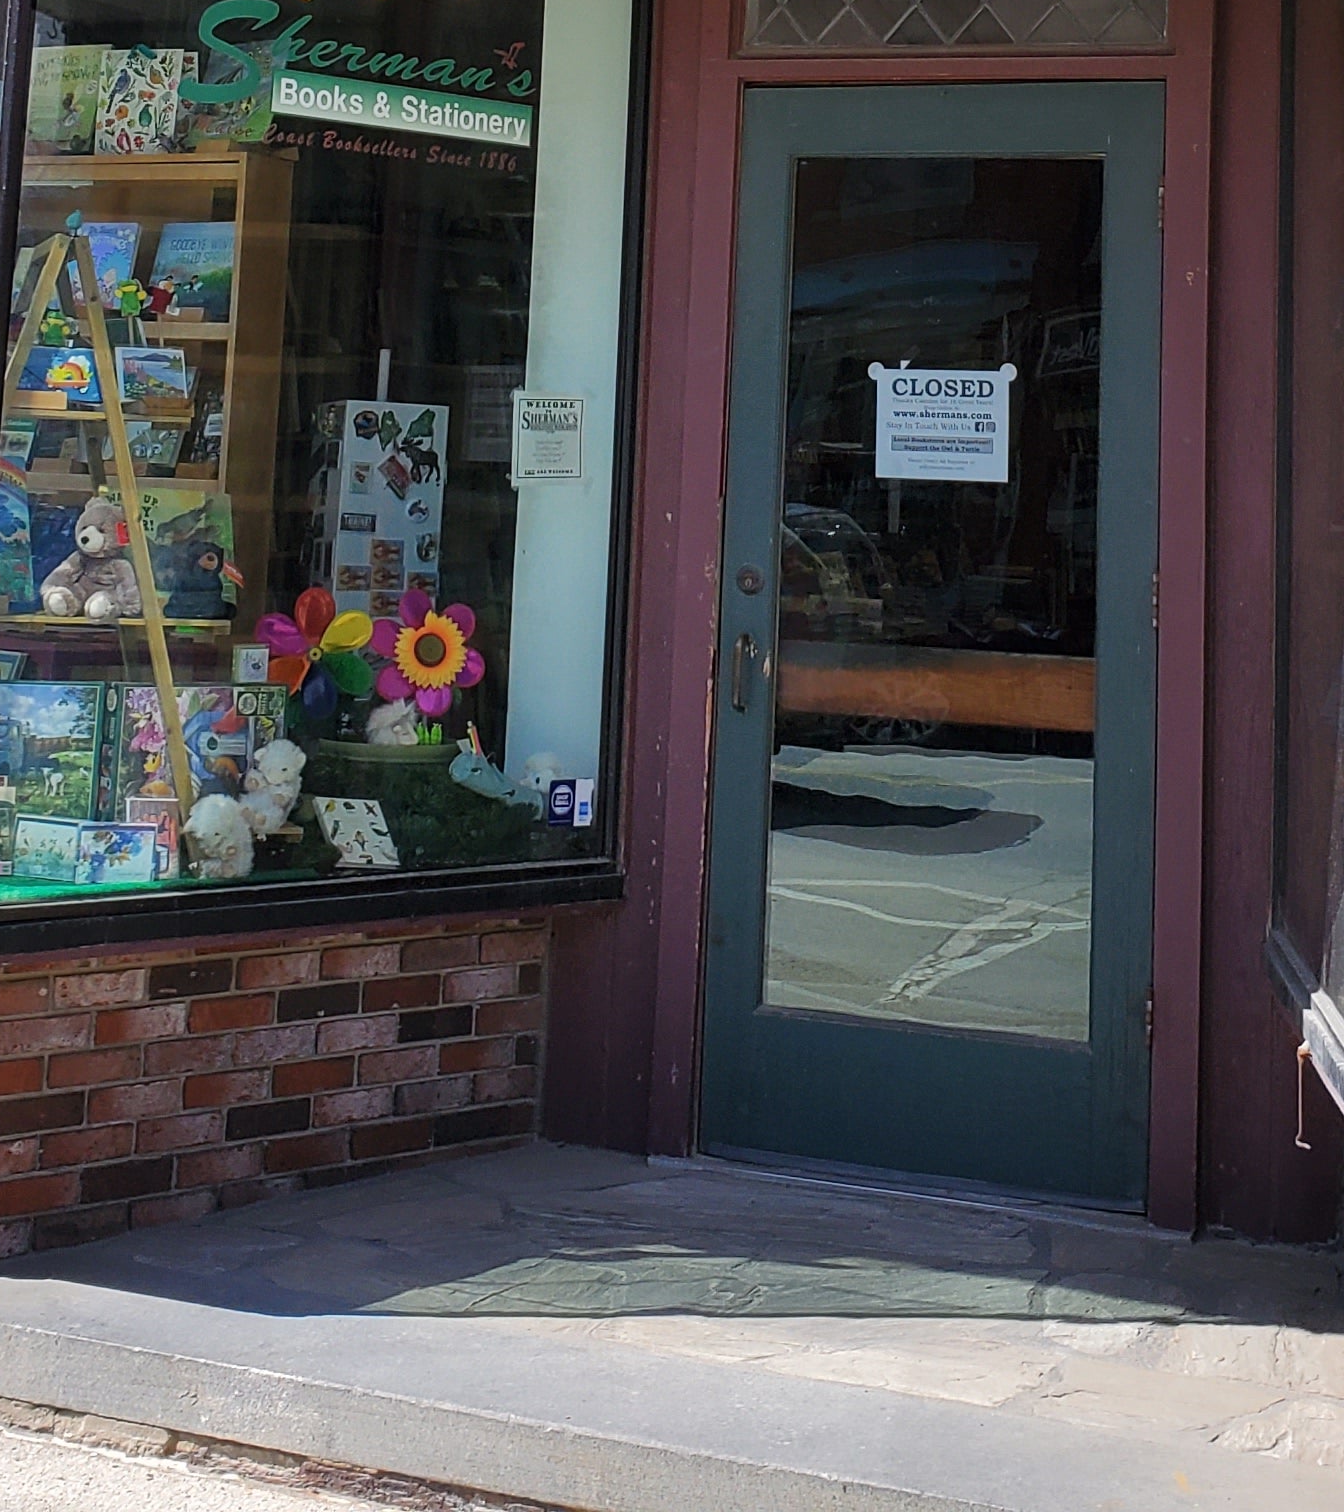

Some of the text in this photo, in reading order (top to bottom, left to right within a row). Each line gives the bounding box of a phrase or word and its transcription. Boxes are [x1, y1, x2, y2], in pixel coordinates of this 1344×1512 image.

[280, 78, 526, 141] Books & Stationery
[263, 123, 517, 172] Coast Booksellers Since 1886
[892, 378, 994, 398] CLOSED
[526, 401, 576, 409] WELCOME
[522, 411, 578, 430] SHERMAN'S
[893, 410, 992, 420] www.shermans.com
